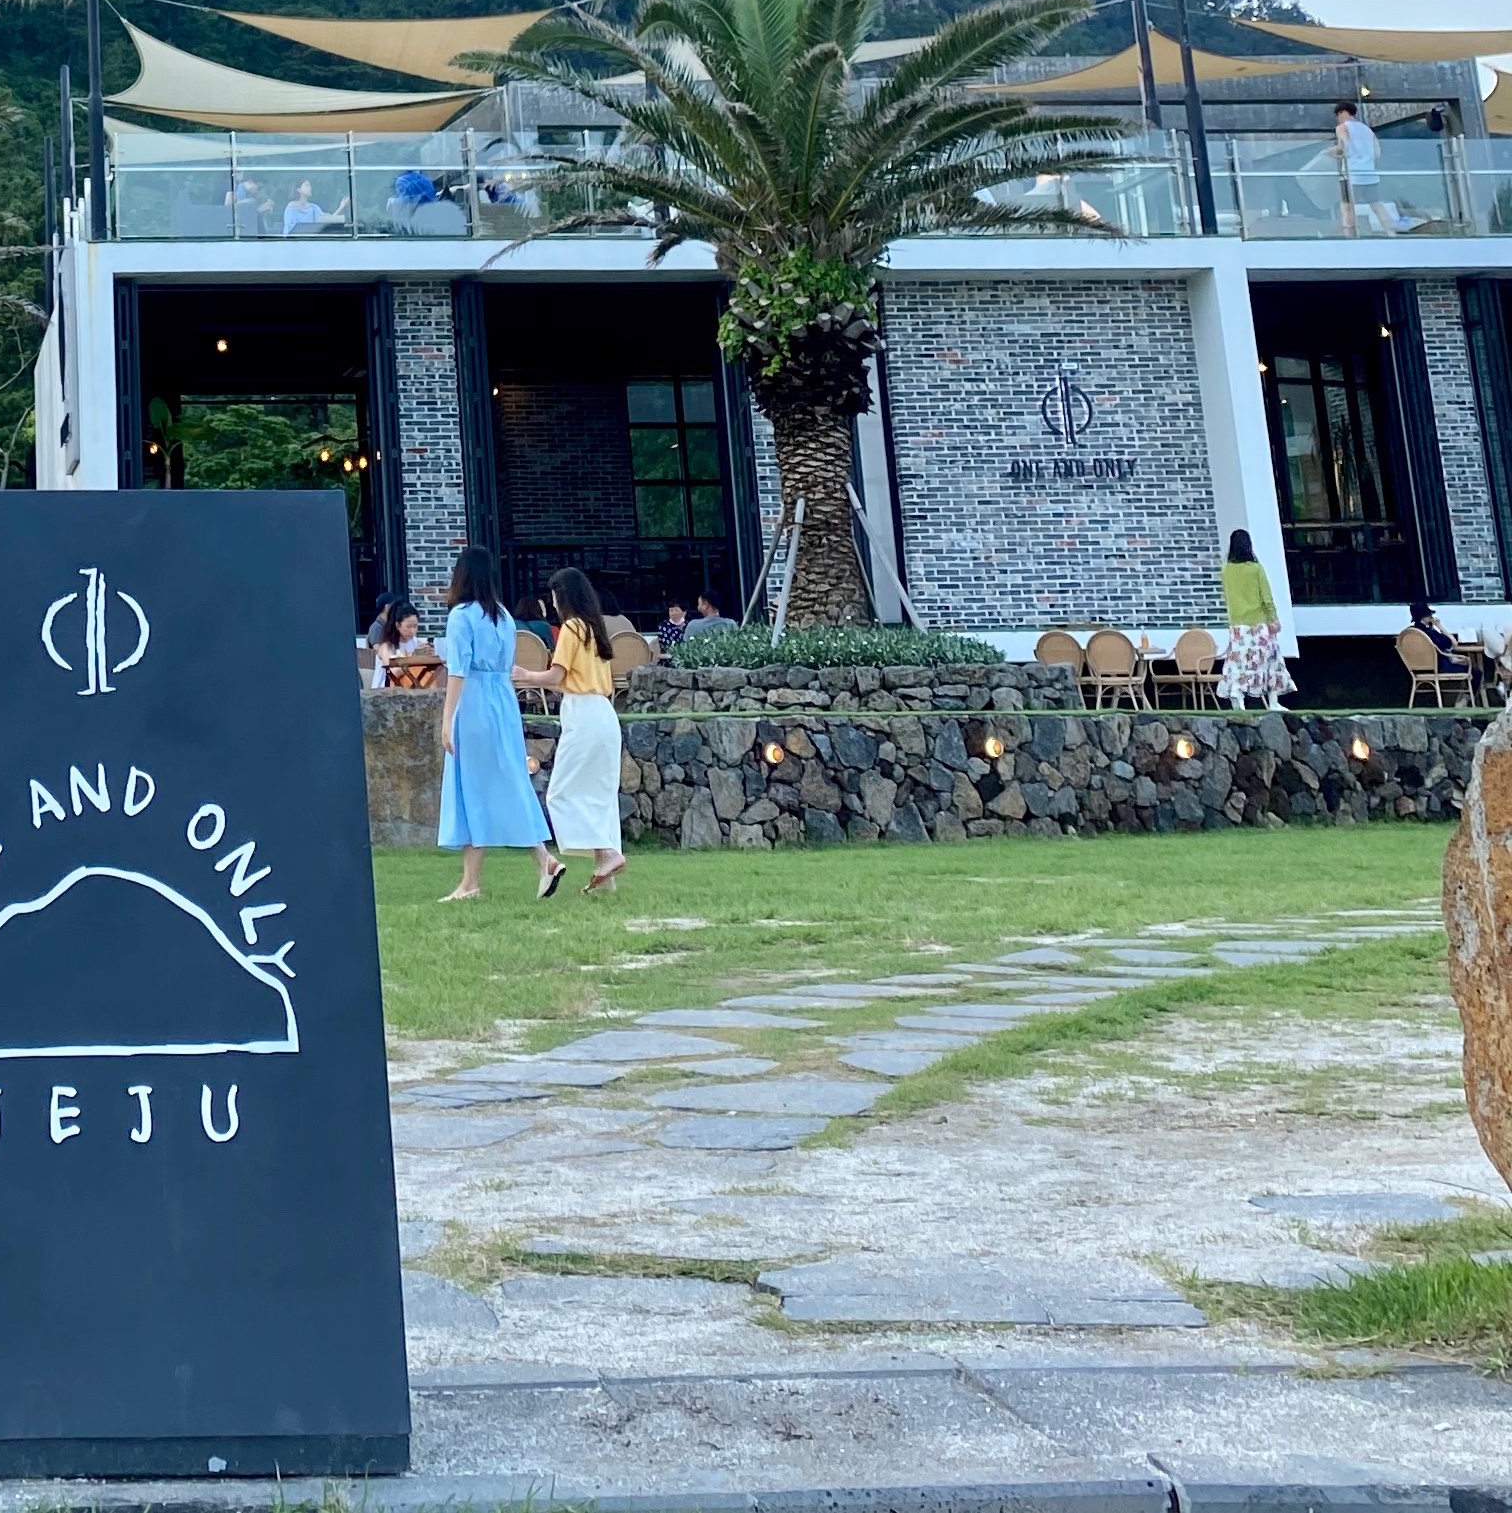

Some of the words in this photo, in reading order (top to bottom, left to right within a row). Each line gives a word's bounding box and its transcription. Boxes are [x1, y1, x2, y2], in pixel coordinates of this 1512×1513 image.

[1052, 457, 1086, 478] AND
[28, 762, 156, 829] AND
[186, 802, 297, 978] ONLY
